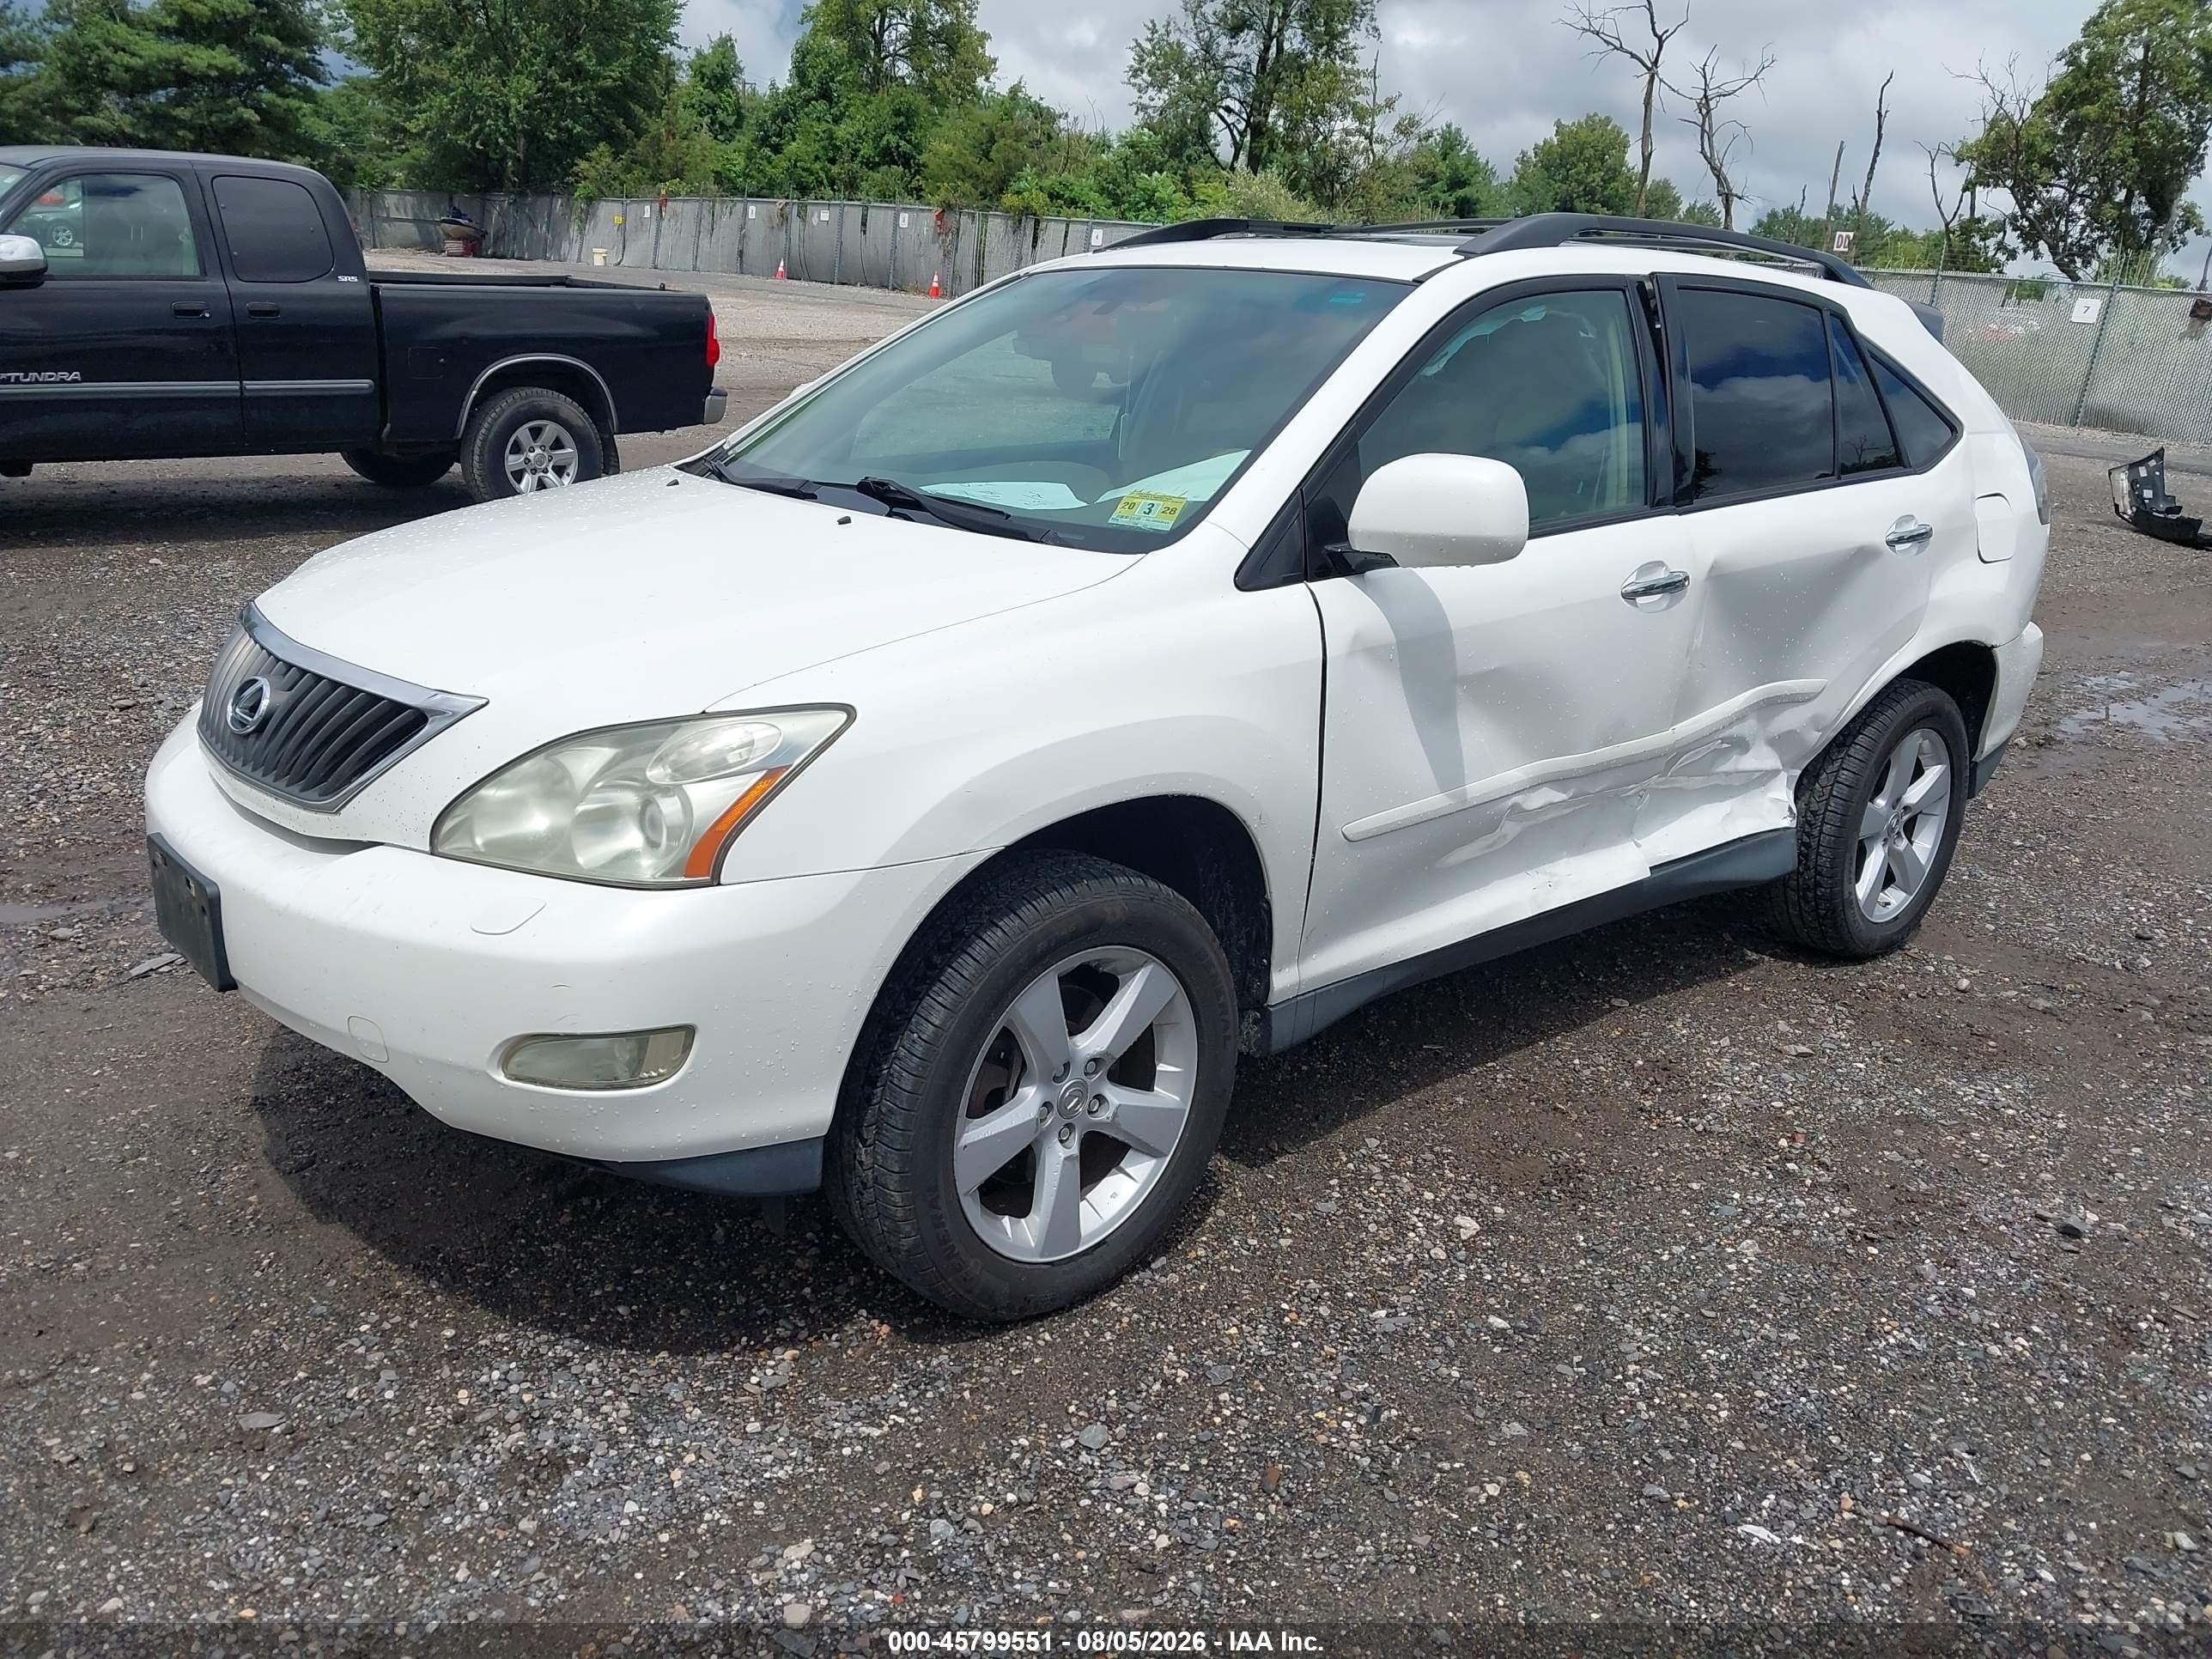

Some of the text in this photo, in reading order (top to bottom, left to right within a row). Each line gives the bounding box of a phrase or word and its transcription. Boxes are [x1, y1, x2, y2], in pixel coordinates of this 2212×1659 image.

[2082, 306, 2091, 314] 7
[7, 371, 82, 383] TUNDRA
[1121, 501, 1137, 511] 20
[1143, 502, 1155, 515] 3
